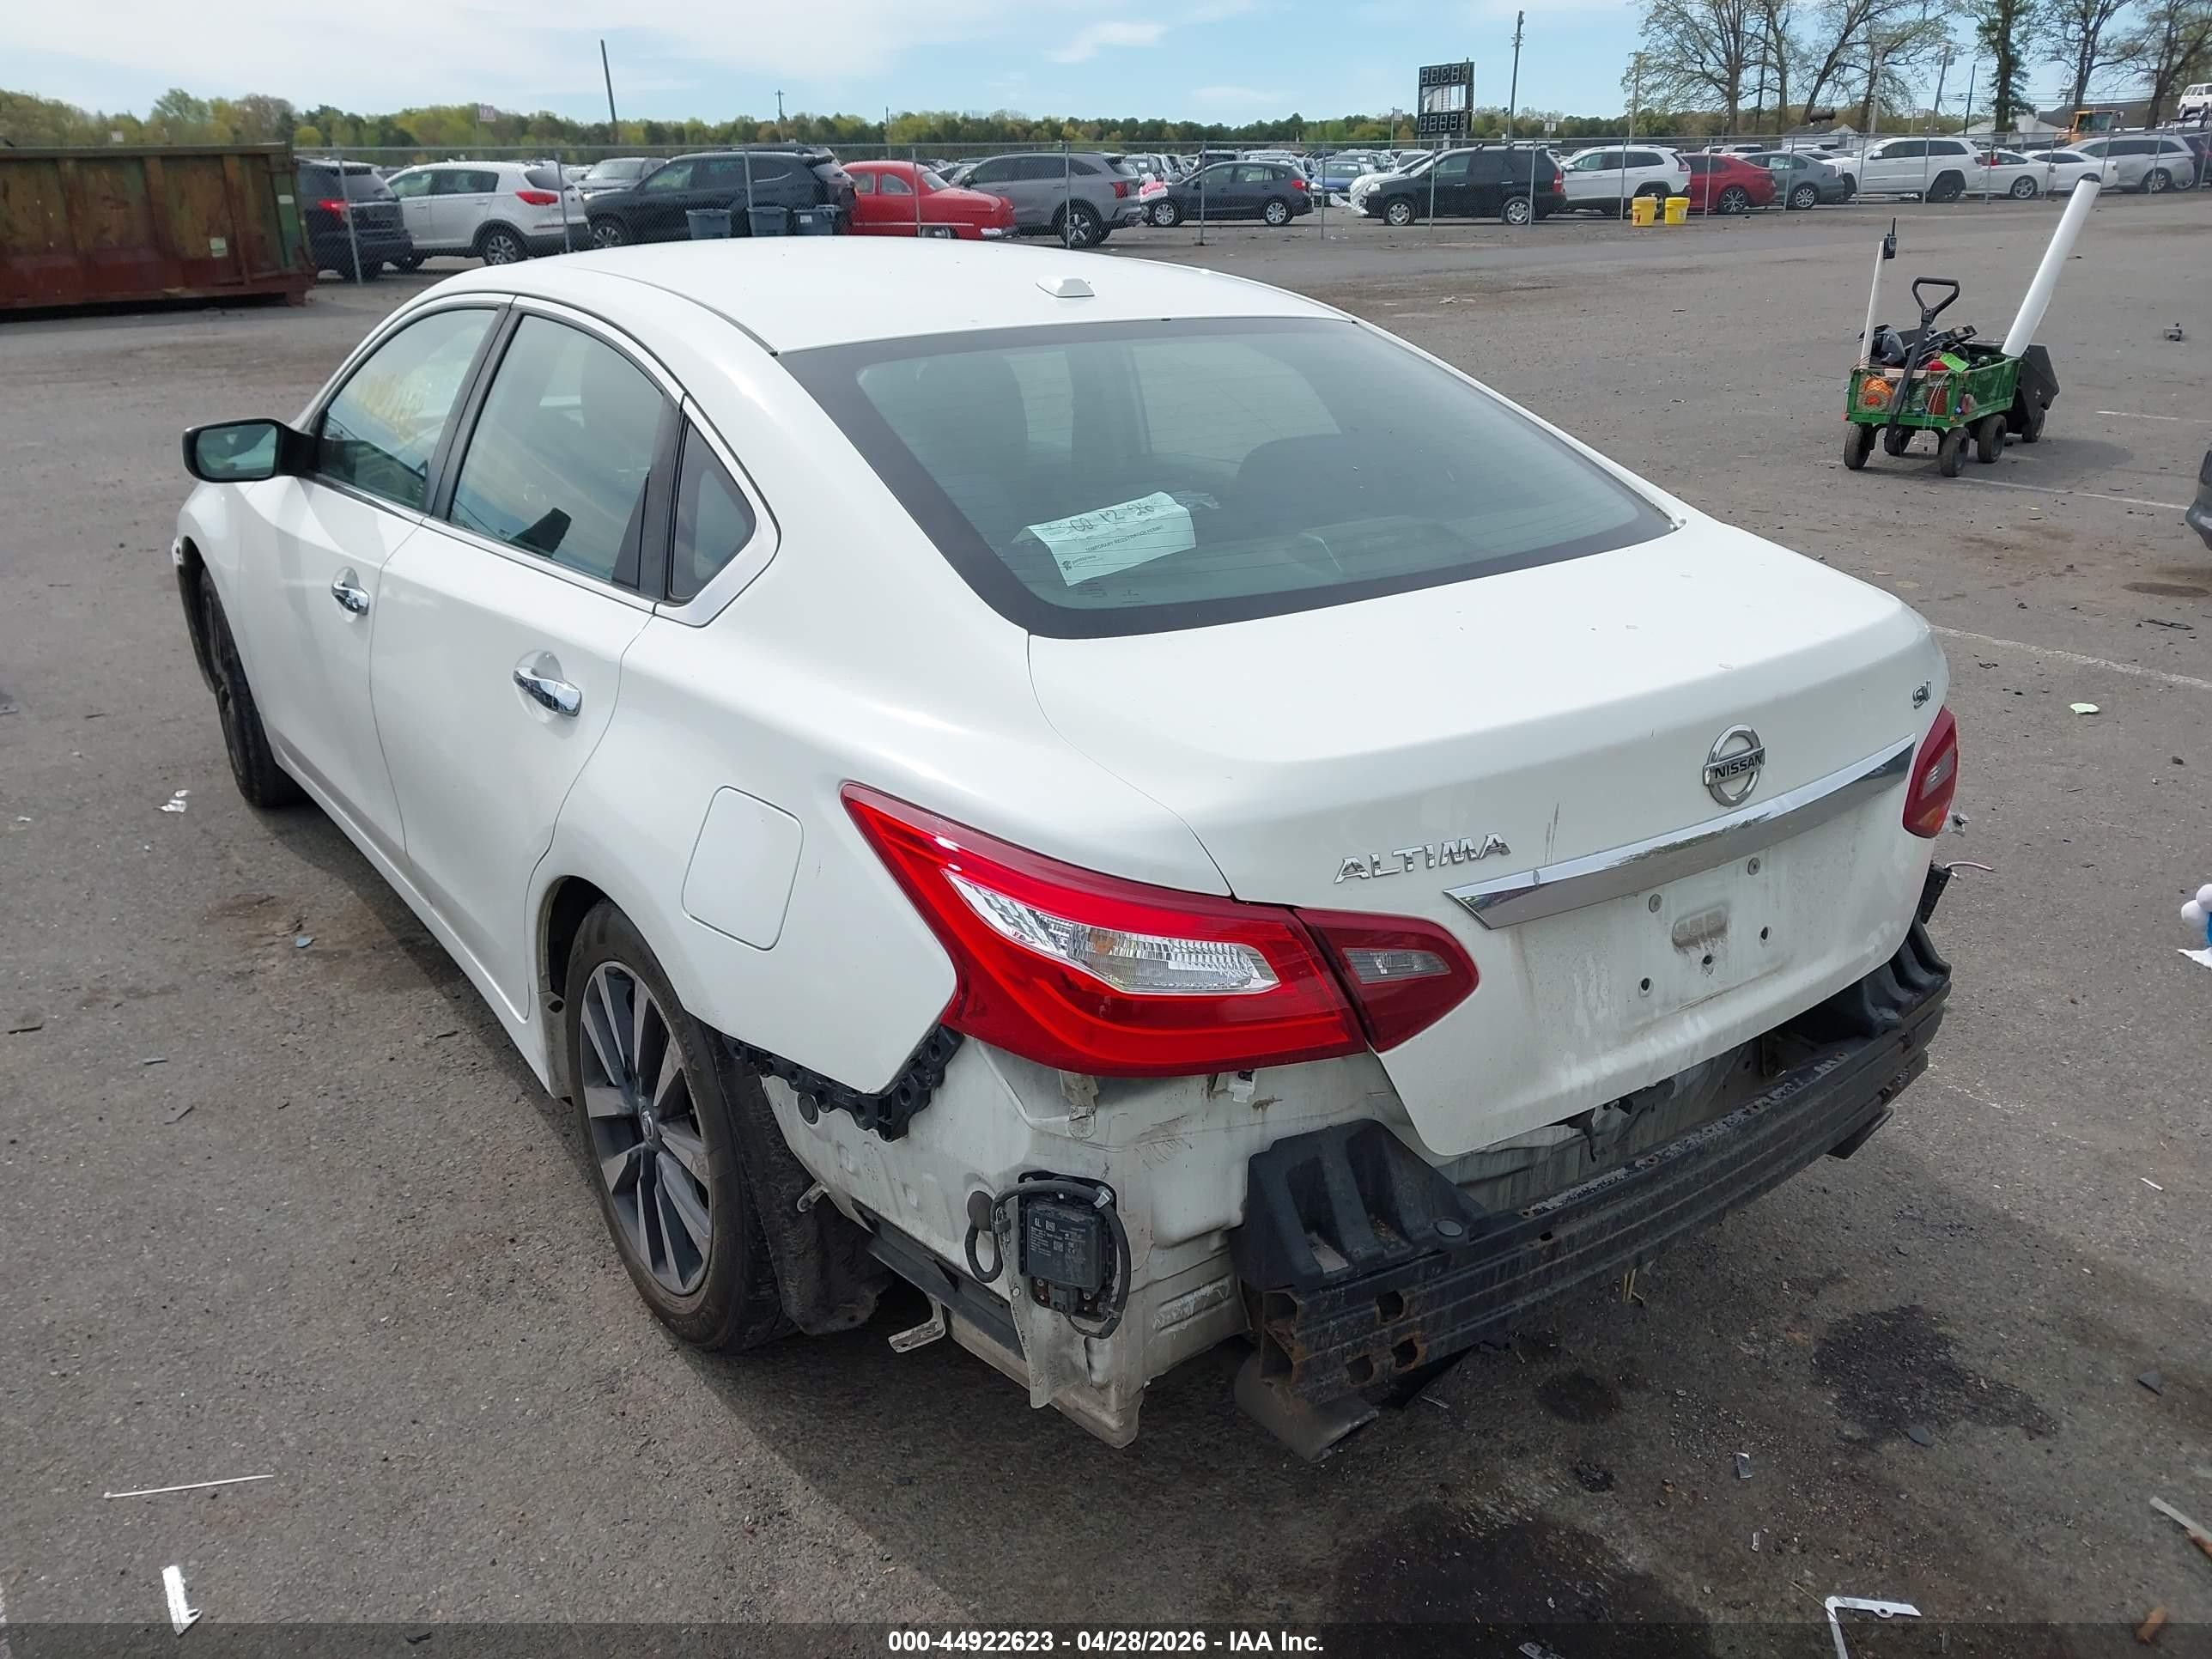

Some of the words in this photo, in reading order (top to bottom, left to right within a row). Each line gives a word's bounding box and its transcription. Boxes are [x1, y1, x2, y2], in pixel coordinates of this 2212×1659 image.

[1099, 510, 1124, 522] 12
[1715, 754, 1763, 779] NISSAN
[1334, 832, 1511, 884] ALTIMA
